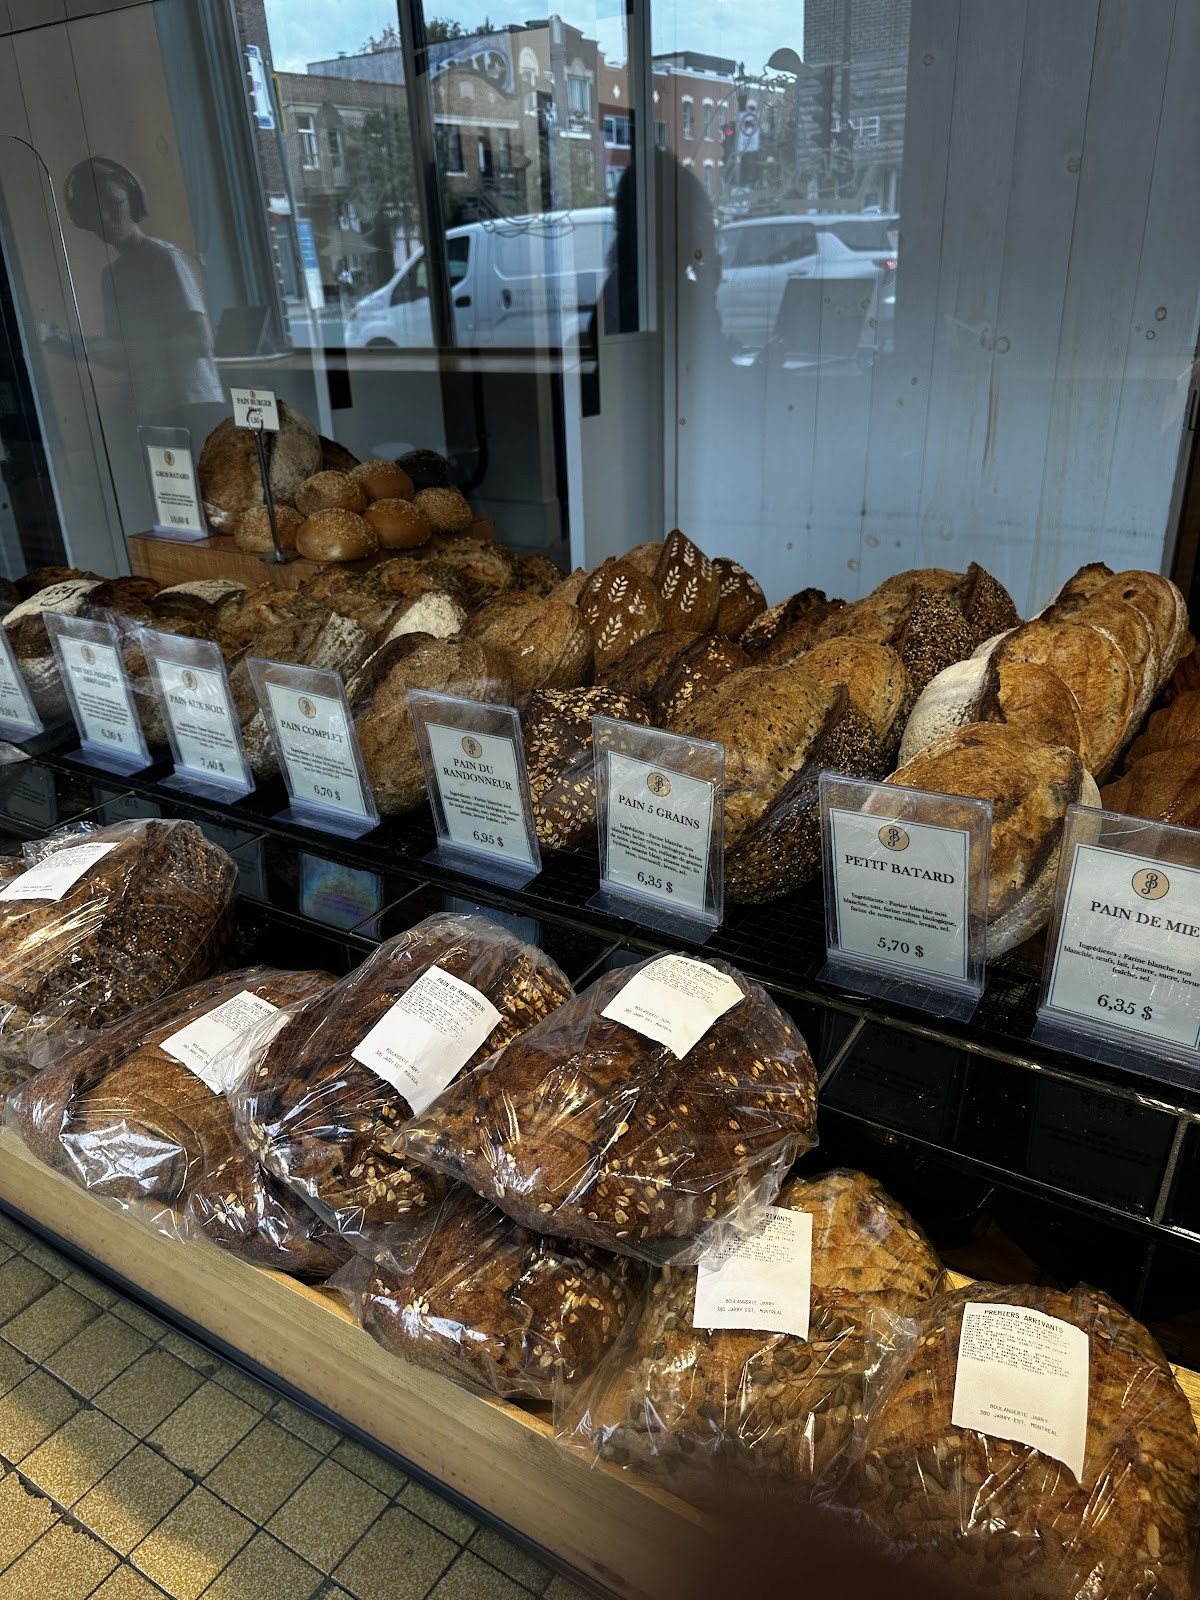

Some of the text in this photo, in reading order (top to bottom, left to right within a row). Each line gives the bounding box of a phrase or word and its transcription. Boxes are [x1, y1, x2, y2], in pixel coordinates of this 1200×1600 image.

[169, 695, 225, 715] PAIN AUX NOIX
[280, 720, 344, 743] PAIN COMPLET
[219, 762, 225, 772] $
[453, 757, 494, 774] PAIN DU
[443, 767, 513, 790] RANDONNEUR
[314, 785, 341, 801] 6,70 $
[619, 794, 700, 830] PAIN 5 GRAINS
[473, 830, 504, 847] 6,95 $
[844, 854, 955, 885] PETIT BATARD
[637, 871, 673, 893] 6,35 $
[884, 906, 901, 915] farine
[889, 900, 908, 909] Farine
[909, 905, 933, 915] blanche
[1090, 900, 1200, 938] PAIN DE MIE
[877, 937, 924, 958] 5,70 $
[1079, 941, 1117, 957] Ingrédients
[1123, 953, 1146, 964] Farine
[1147, 959, 1176, 973] blanche
[1064, 946, 1094, 960] blanchie,
[1116, 961, 1130, 969] lait,
[1131, 964, 1157, 976] beurre,
[1159, 973, 1180, 983] sucre,
[1182, 977, 1200, 988] levur
[437, 977, 449, 987] PAIN
[1097, 994, 1153, 1020] 6,35 $
[765, 1212, 792, 1223] RIVANTS
[984, 1309, 1064, 1333] PREMIERS ARRIVANTS
[990, 1404, 1048, 1424] BOULANGERIE JARRY
[1031, 1423, 1058, 1436] MONTREAL
